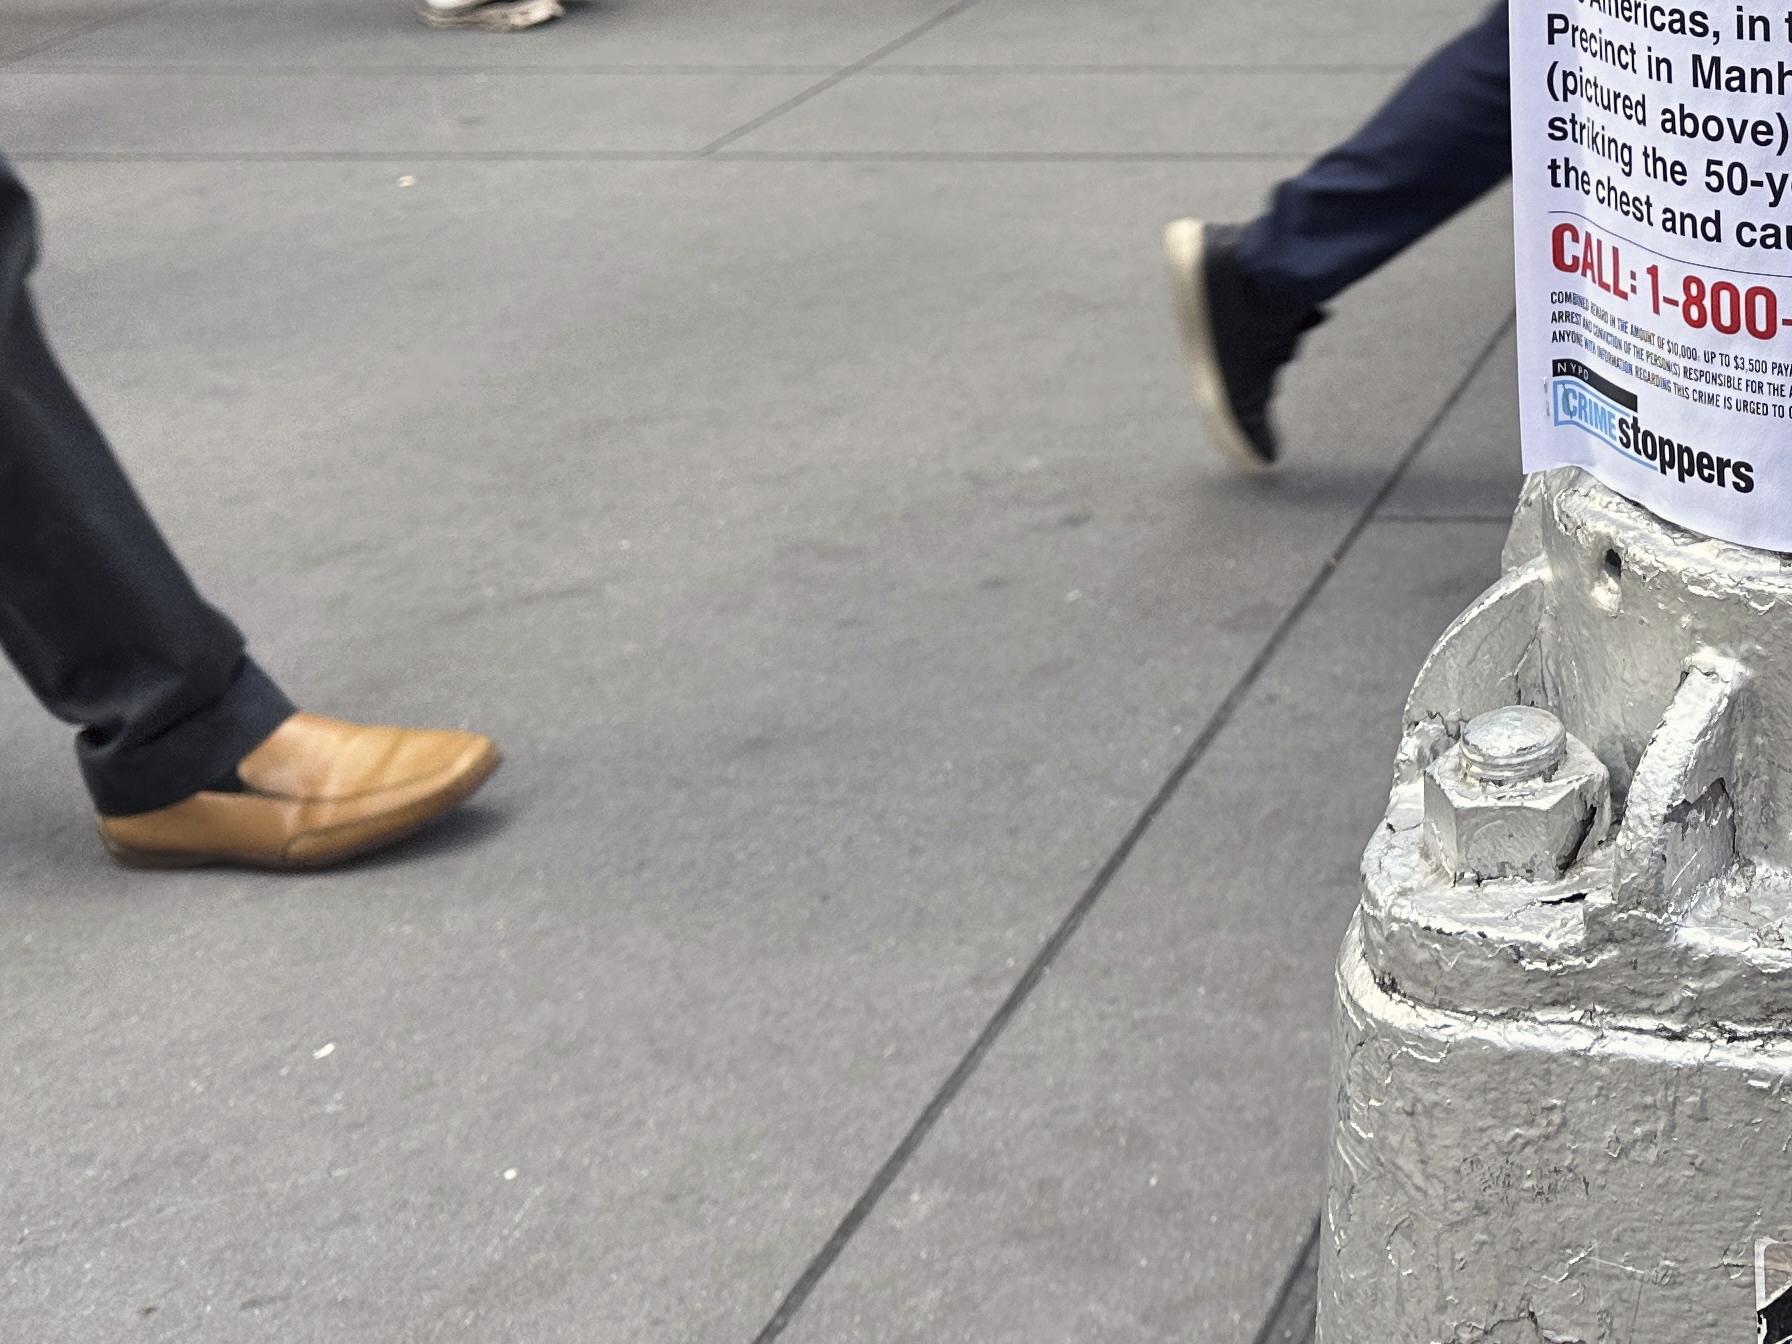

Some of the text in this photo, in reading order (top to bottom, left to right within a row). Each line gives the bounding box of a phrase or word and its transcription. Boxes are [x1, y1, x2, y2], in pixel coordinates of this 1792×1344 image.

[1547, 13, 1636, 74] Precinct
[1647, 46, 1673, 84] in
[1736, 6, 1770, 42] in
[1547, 61, 1646, 126] (pictured
[1661, 103, 1788, 156] above)
[1548, 113, 1632, 176] striking
[1642, 145, 1687, 186] the
[1548, 157, 1590, 195] the
[1596, 175, 1653, 227] chest
[1662, 206, 1721, 243] and
[1552, 223, 1637, 301] CALL:
[1551, 311, 1581, 326] ARREST
[1624, 341, 1631, 355] OF
[1633, 344, 1644, 361] THE
[1683, 366, 1742, 391] RESPONSIBLE
[1746, 379, 1764, 395] FOR
[1767, 381, 1786, 398] THE
[1552, 330, 1583, 347] ANYONE
[1673, 382, 1689, 400] THIS
[1693, 389, 1720, 408] CRIME
[1724, 396, 1732, 410] IS
[1736, 398, 1768, 416] URGED
[1772, 404, 1784, 418] TO
[1657, 336, 1666, 350] OF
[1704, 350, 1716, 364] UP
[1719, 353, 1730, 367] TO
[1734, 355, 1767, 374] $3,500
